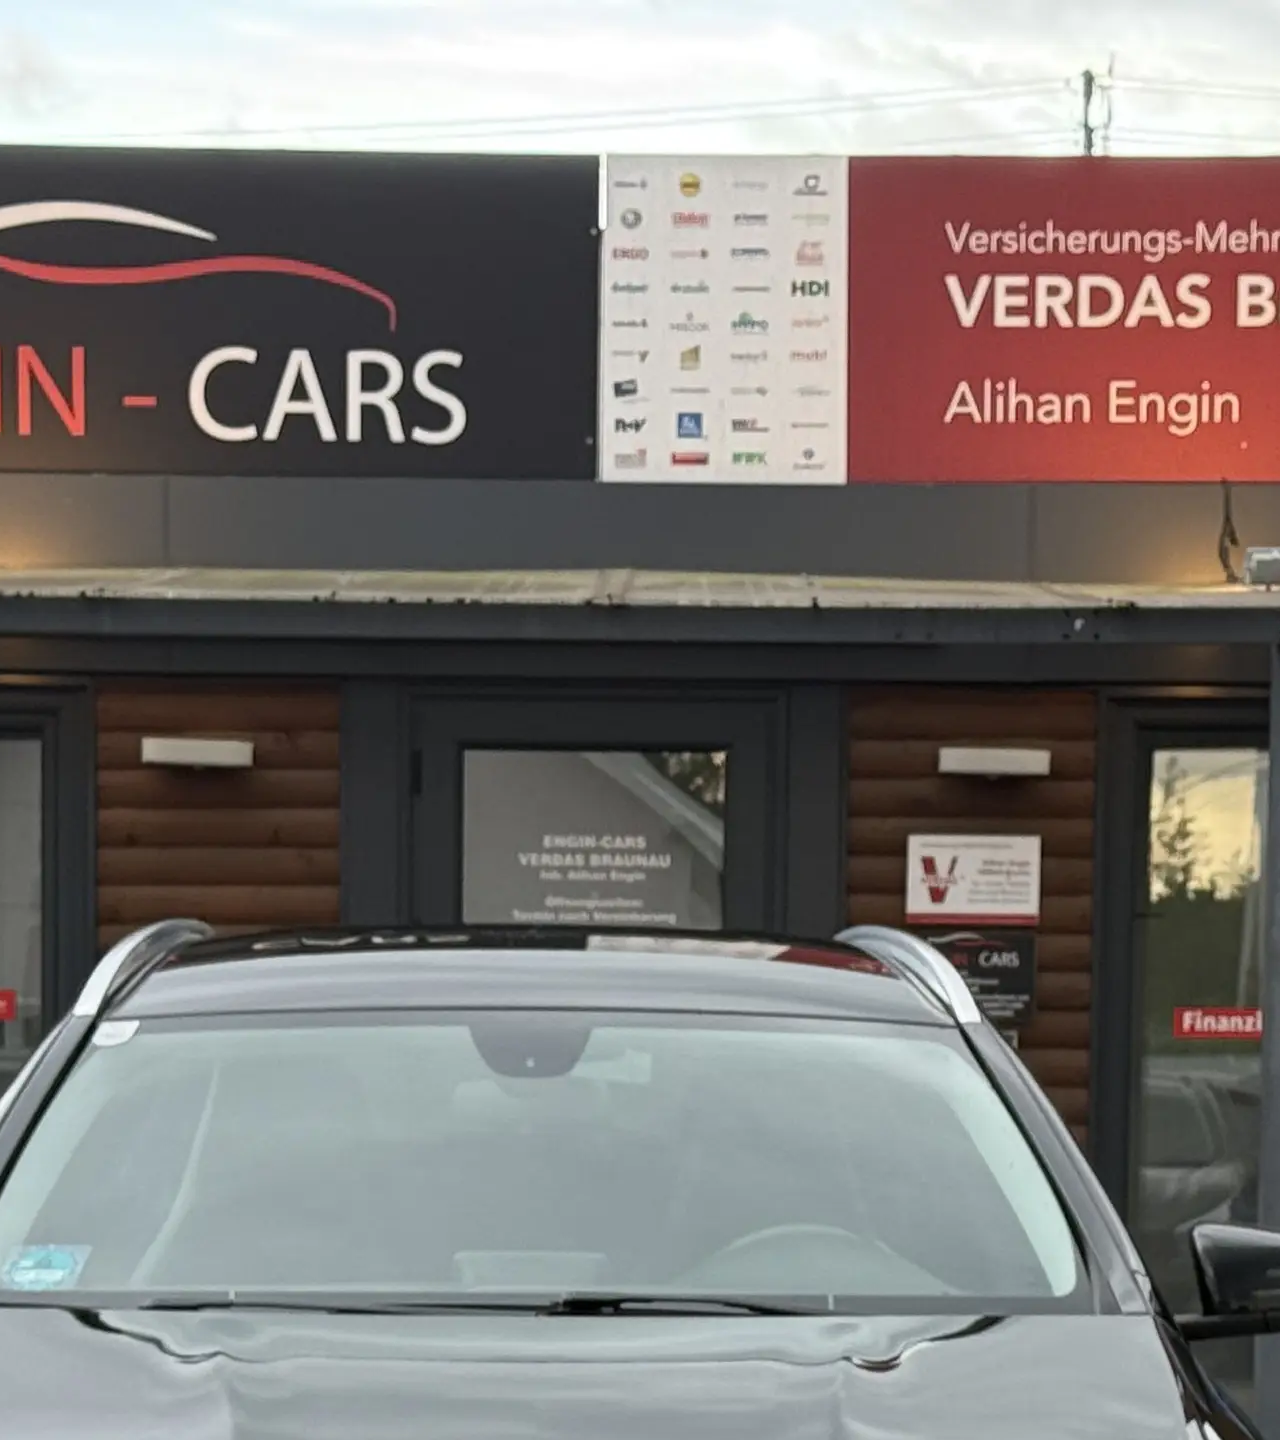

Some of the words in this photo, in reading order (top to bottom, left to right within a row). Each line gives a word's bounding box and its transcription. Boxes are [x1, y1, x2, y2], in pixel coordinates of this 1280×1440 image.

[791, 280, 830, 297] HDI
[944, 273, 1212, 329] VERDAS
[123, 395, 157, 407] -
[187, 346, 467, 445] CARS
[943, 378, 1092, 424] Alihan
[1108, 379, 1240, 437] Engin
[518, 852, 586, 867] VERDAS
[589, 853, 672, 868] BRAUNAU
[978, 950, 1019, 968] CARS
